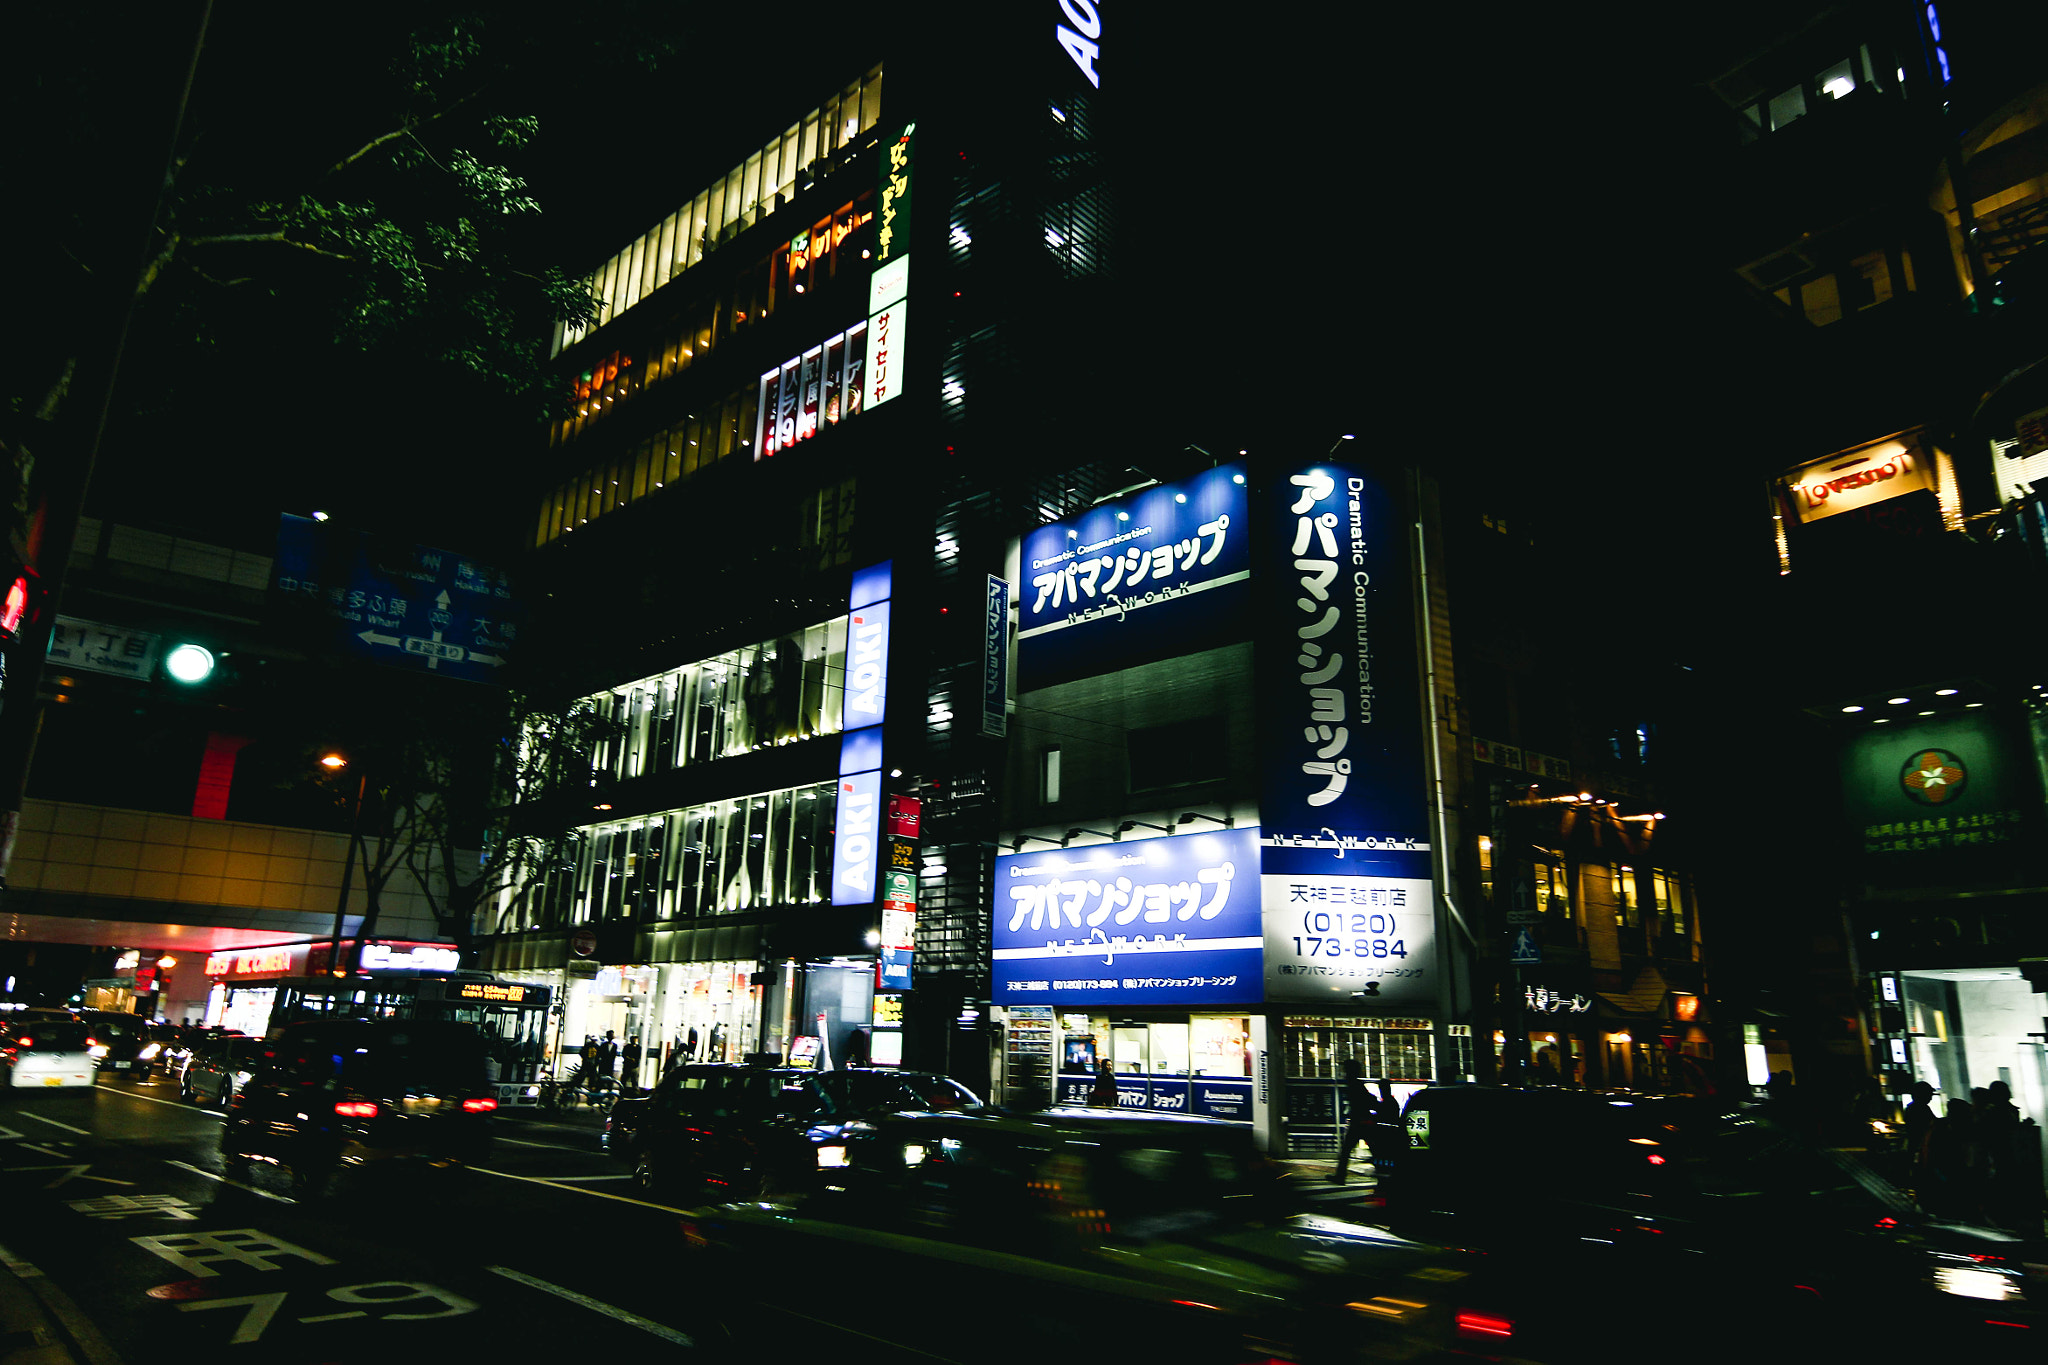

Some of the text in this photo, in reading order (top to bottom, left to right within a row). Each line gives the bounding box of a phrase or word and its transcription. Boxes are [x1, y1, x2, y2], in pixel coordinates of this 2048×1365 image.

[1056, 0, 1101, 89] AO
[874, 312, 890, 402] サイゼリヤ
[1032, 514, 1230, 614] アパマンショップ
[1347, 477, 1375, 725] Dramatic Communication
[851, 620, 883, 716] AOKI
[986, 583, 1001, 694] アパマンショップ
[1290, 474, 1352, 807] アパマンショップ
[840, 792, 874, 893] AOKI
[1007, 861, 1236, 932] アパマンショップ
[1289, 884, 1407, 906] 天神三越前店
[1303, 910, 1396, 936] (0120)
[1292, 936, 1408, 959] 173-884
